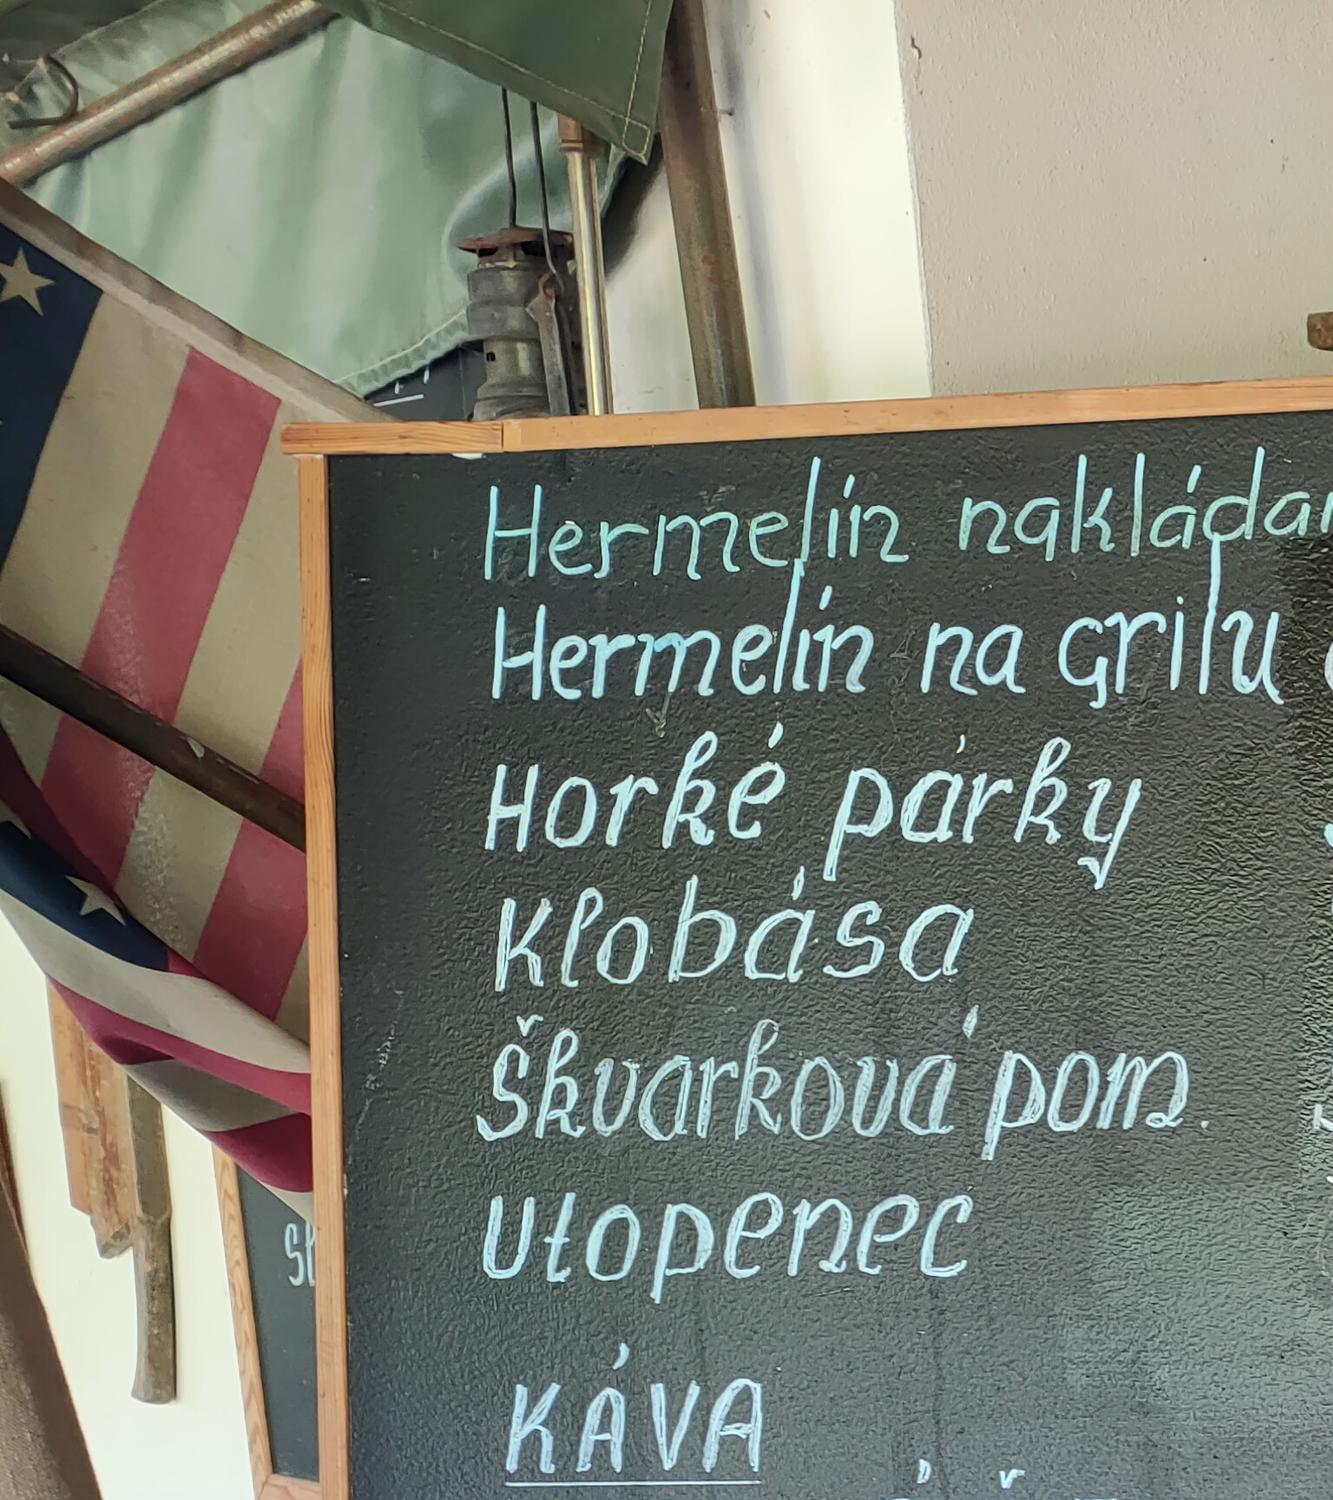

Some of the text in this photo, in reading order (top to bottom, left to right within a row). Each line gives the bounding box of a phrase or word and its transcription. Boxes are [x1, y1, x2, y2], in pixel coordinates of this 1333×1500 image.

[485, 457, 909, 579] Hermelín
[493, 560, 874, 702] Hermelín
[921, 619, 1024, 695] na
[486, 724, 785, 851] Horké
[825, 734, 1143, 888] párky
[496, 866, 973, 992] Klobása
[478, 1004, 978, 1144] Škvarková
[483, 1192, 972, 1302] Utopenec
[505, 1343, 764, 1475] KÁVA
